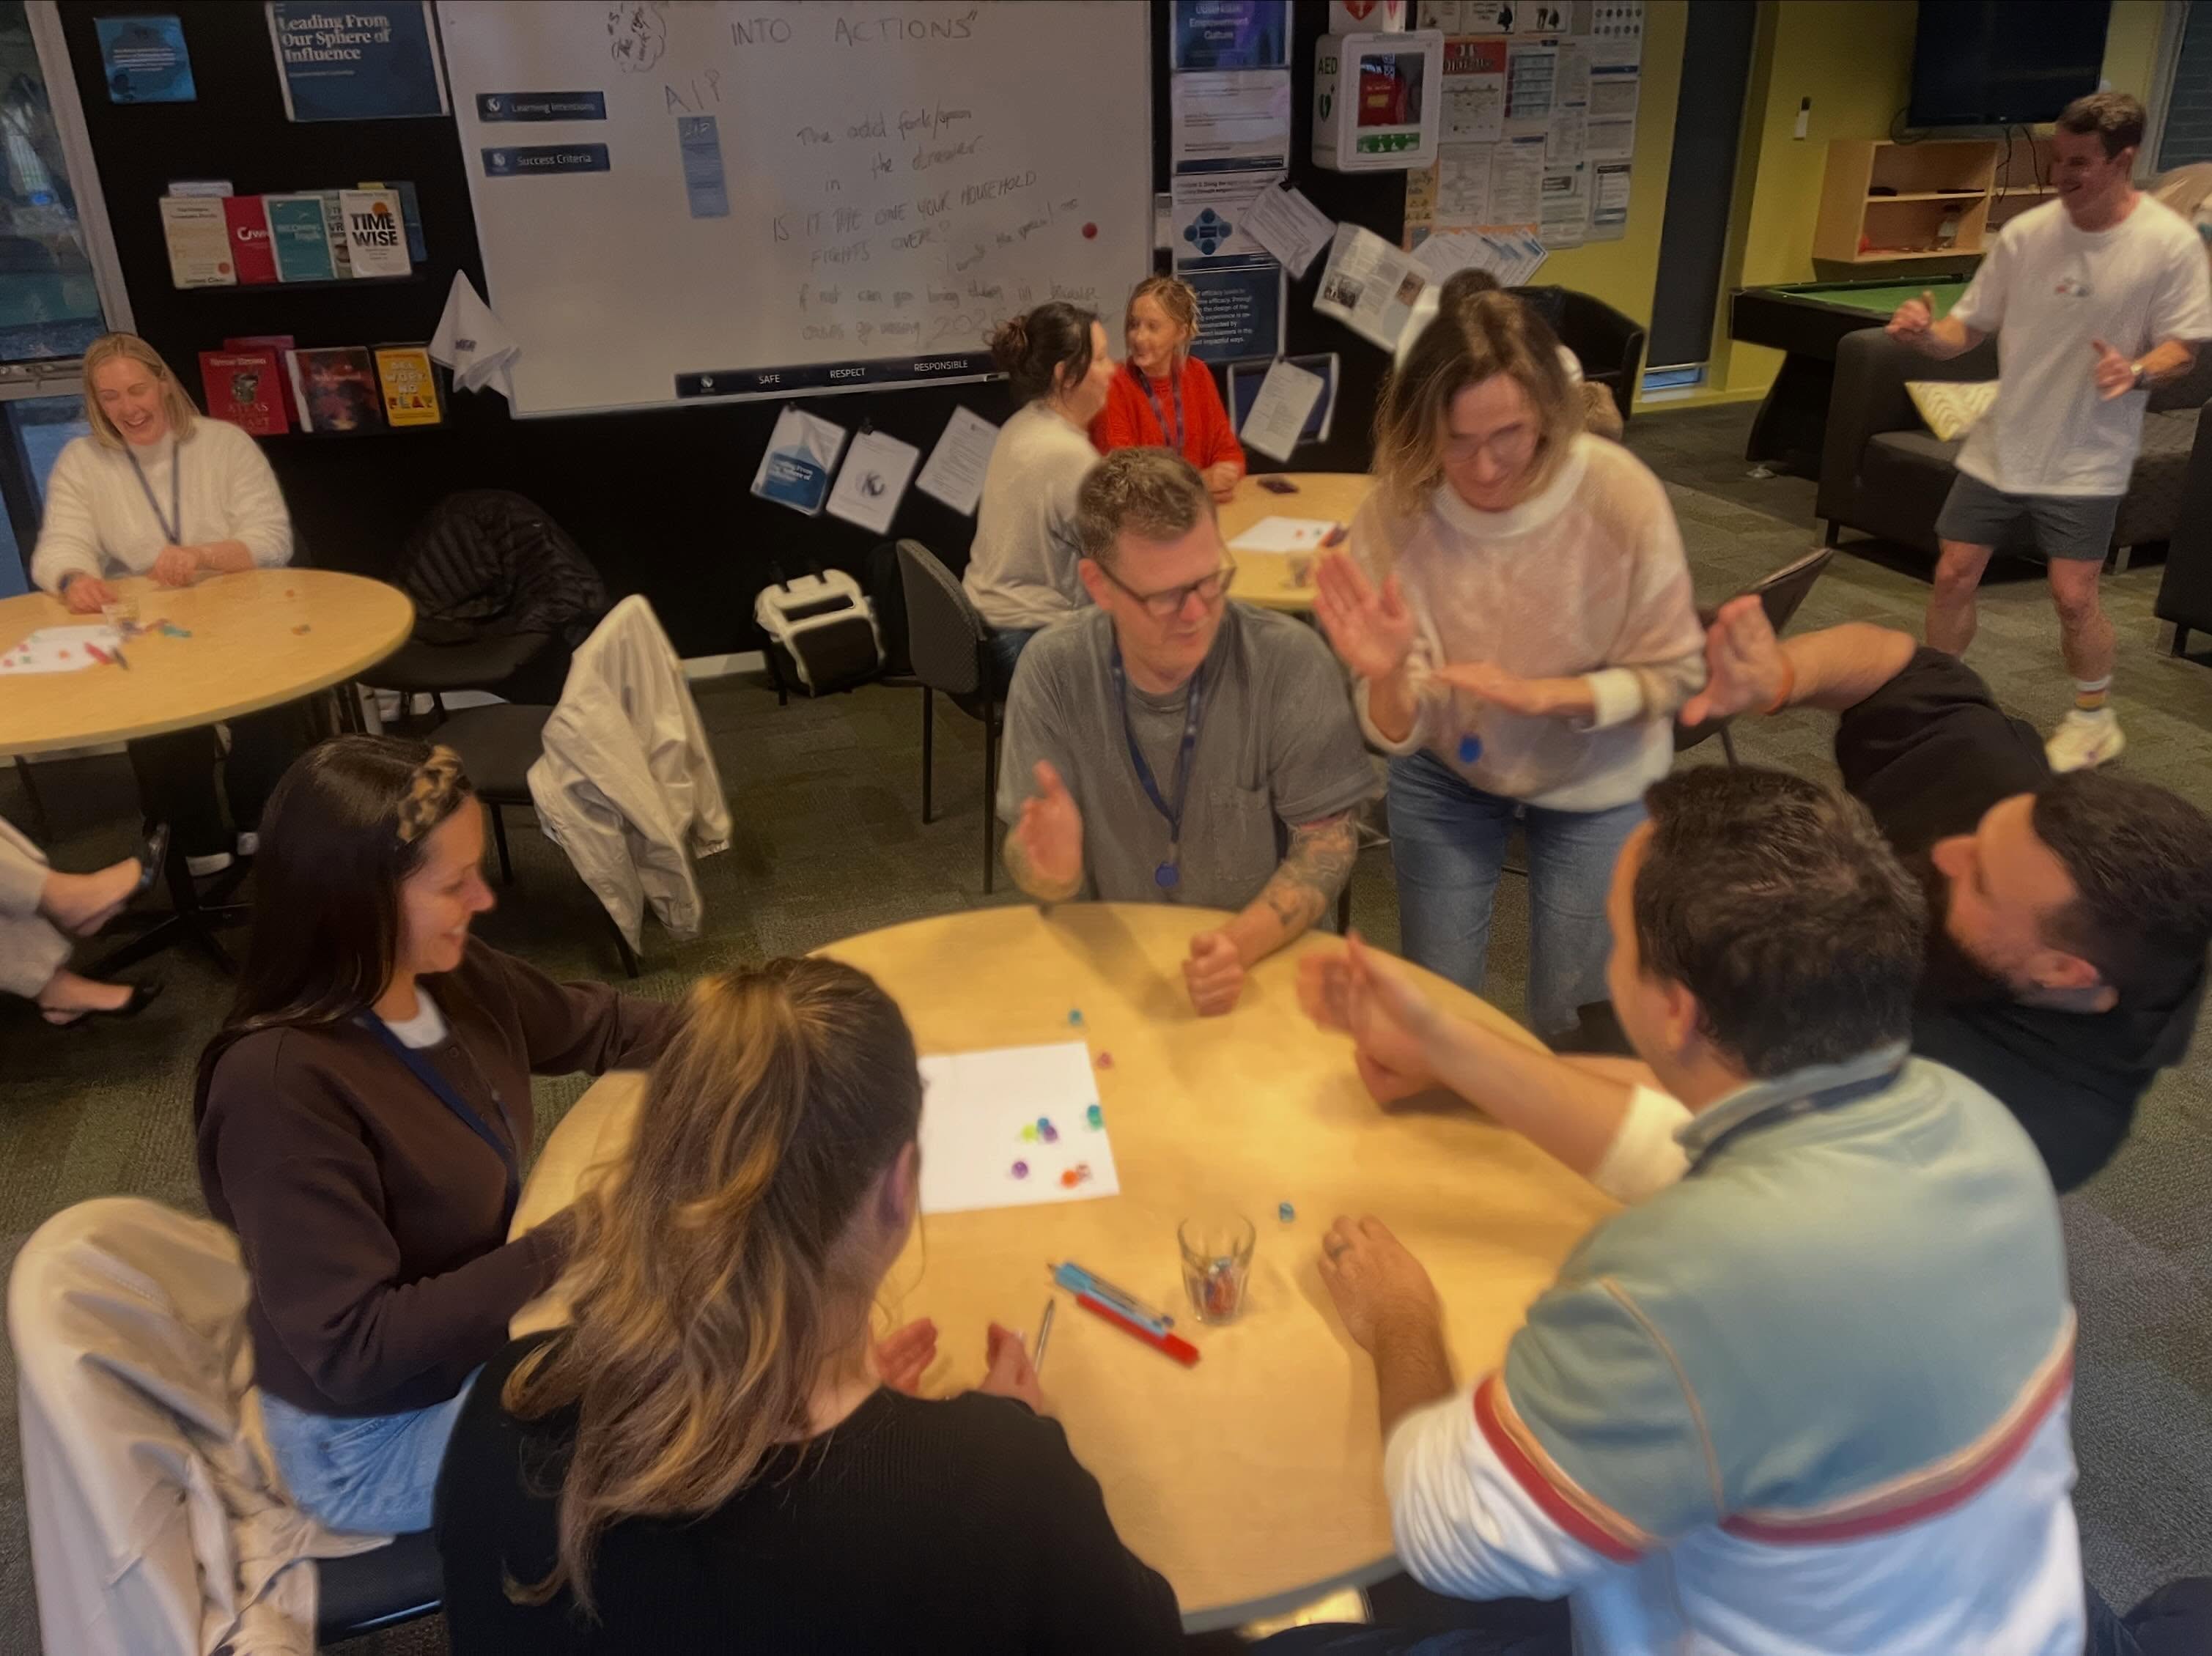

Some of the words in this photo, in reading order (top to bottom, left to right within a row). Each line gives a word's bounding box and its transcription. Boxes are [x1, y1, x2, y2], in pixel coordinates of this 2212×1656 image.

[279, 14, 344, 31] Leading
[346, 14, 389, 28] From
[731, 18, 791, 45] INTO
[281, 32, 312, 47] Our
[317, 30, 371, 48] Sphere
[375, 29, 392, 42] of
[284, 46, 361, 63] Influence
[1319, 57, 1338, 74] AED
[512, 104, 550, 114] Learning
[797, 127, 833, 145] The
[517, 157, 555, 166] Success
[556, 153, 592, 164] Criteria
[825, 179, 841, 191] in
[871, 152, 893, 179] the
[774, 215, 790, 242] IS
[806, 211, 824, 235] IT
[918, 190, 951, 218] YOUR
[961, 170, 1037, 205] HOUSEHOLD
[350, 212, 395, 230] TIME
[352, 232, 399, 246] WISE
[811, 241, 871, 270] FIGHTS
[759, 374, 780, 385] SAFE
[830, 368, 866, 380] RESPECT
[914, 360, 967, 373] RESPONSIBLE
